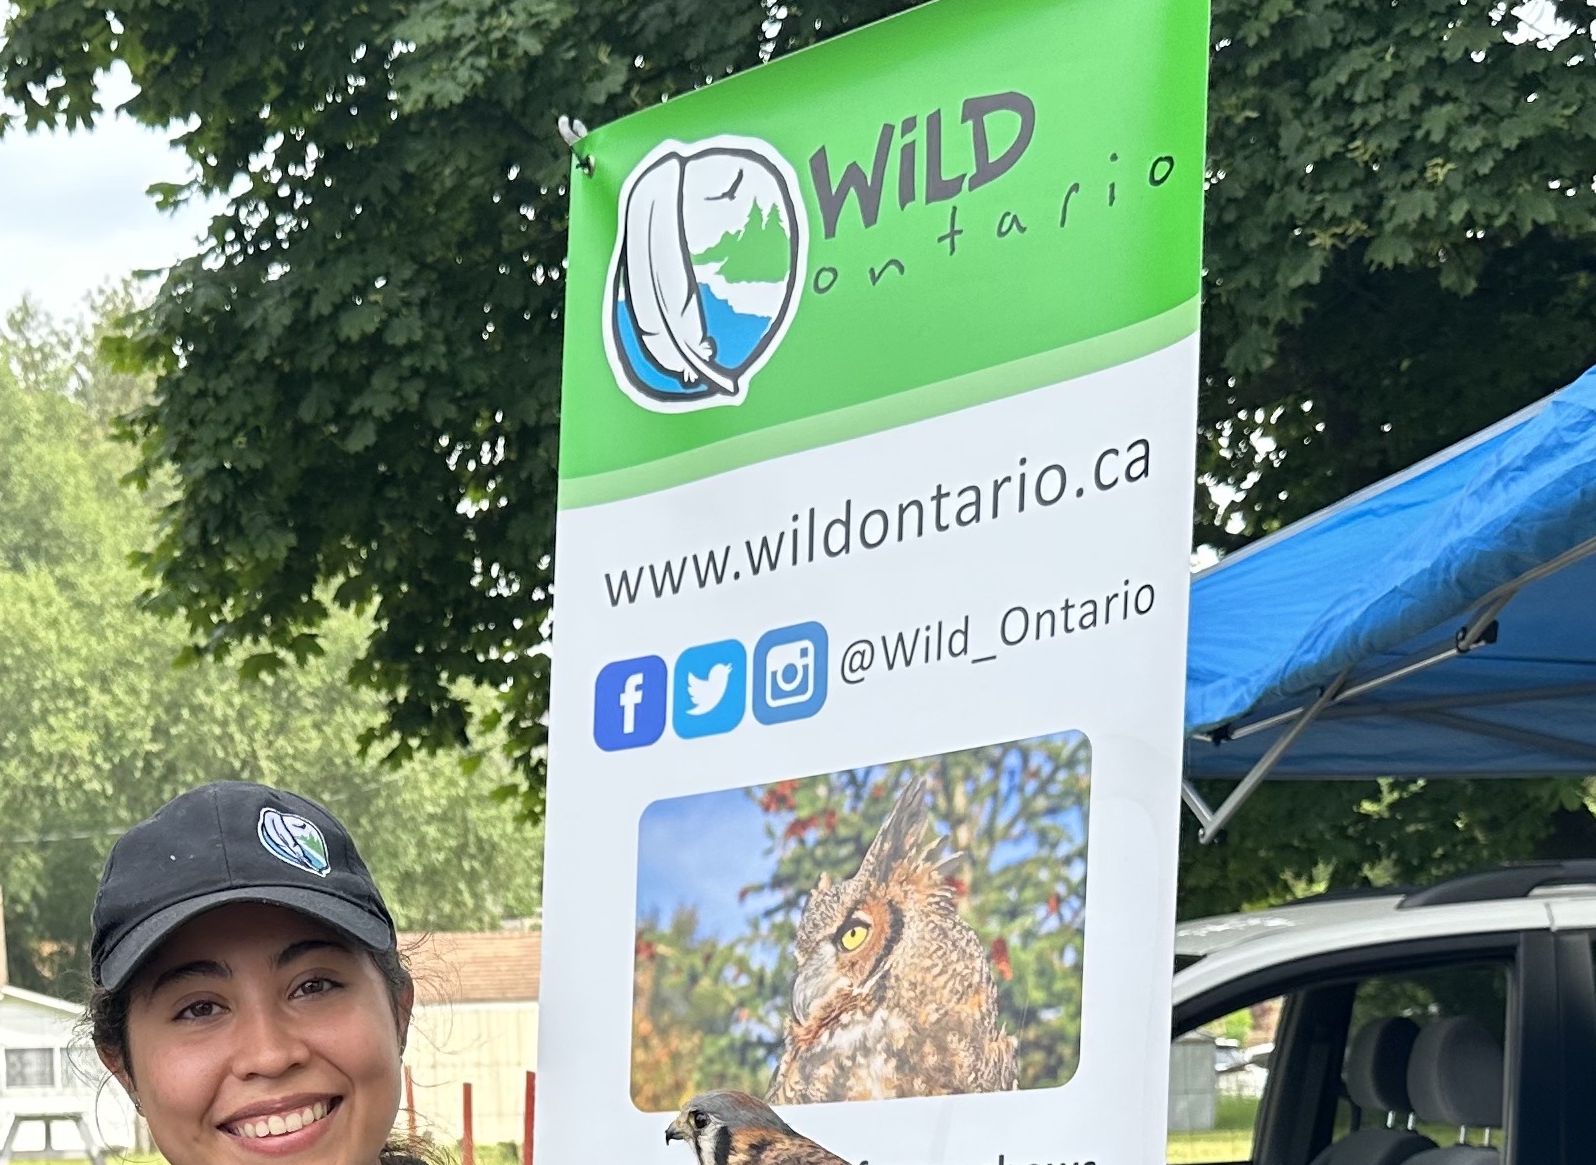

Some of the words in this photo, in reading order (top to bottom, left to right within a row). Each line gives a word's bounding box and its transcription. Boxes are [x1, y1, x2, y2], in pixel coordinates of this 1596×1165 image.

[812, 153, 1174, 295] ontario
[604, 437, 1151, 607] www.wildontario.ca
[839, 578, 1156, 685] @Wild_Ontario
